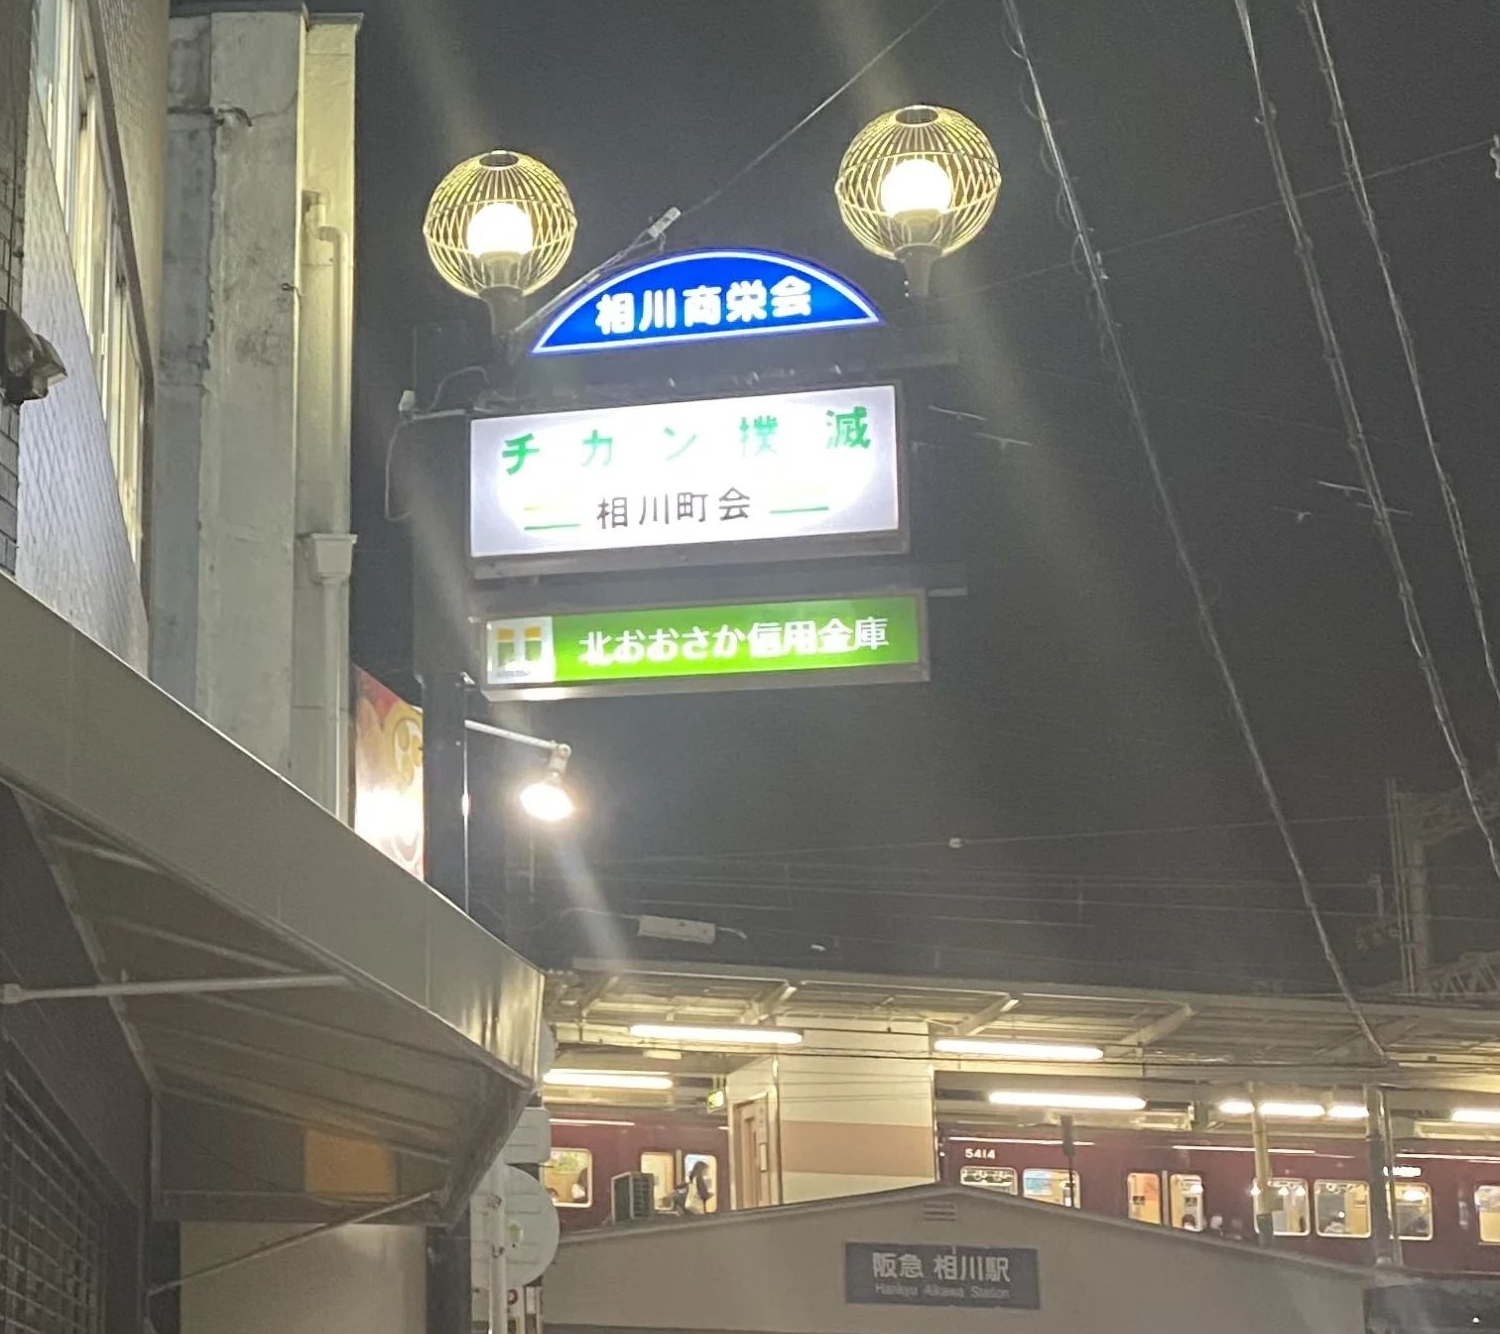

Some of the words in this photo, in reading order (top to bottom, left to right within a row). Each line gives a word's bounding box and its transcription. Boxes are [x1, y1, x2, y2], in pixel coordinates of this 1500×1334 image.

[594, 275, 813, 335] 相川商栄会
[596, 487, 752, 531] 相川町会
[577, 616, 890, 667] 北おおさか信用金庫
[964, 1147, 996, 1160] 5414
[872, 1252, 924, 1279] 阪急
[933, 1254, 1011, 1283] 相川駅
[875, 1283, 918, 1298] Hankyu
[971, 1285, 1011, 1299] Station
